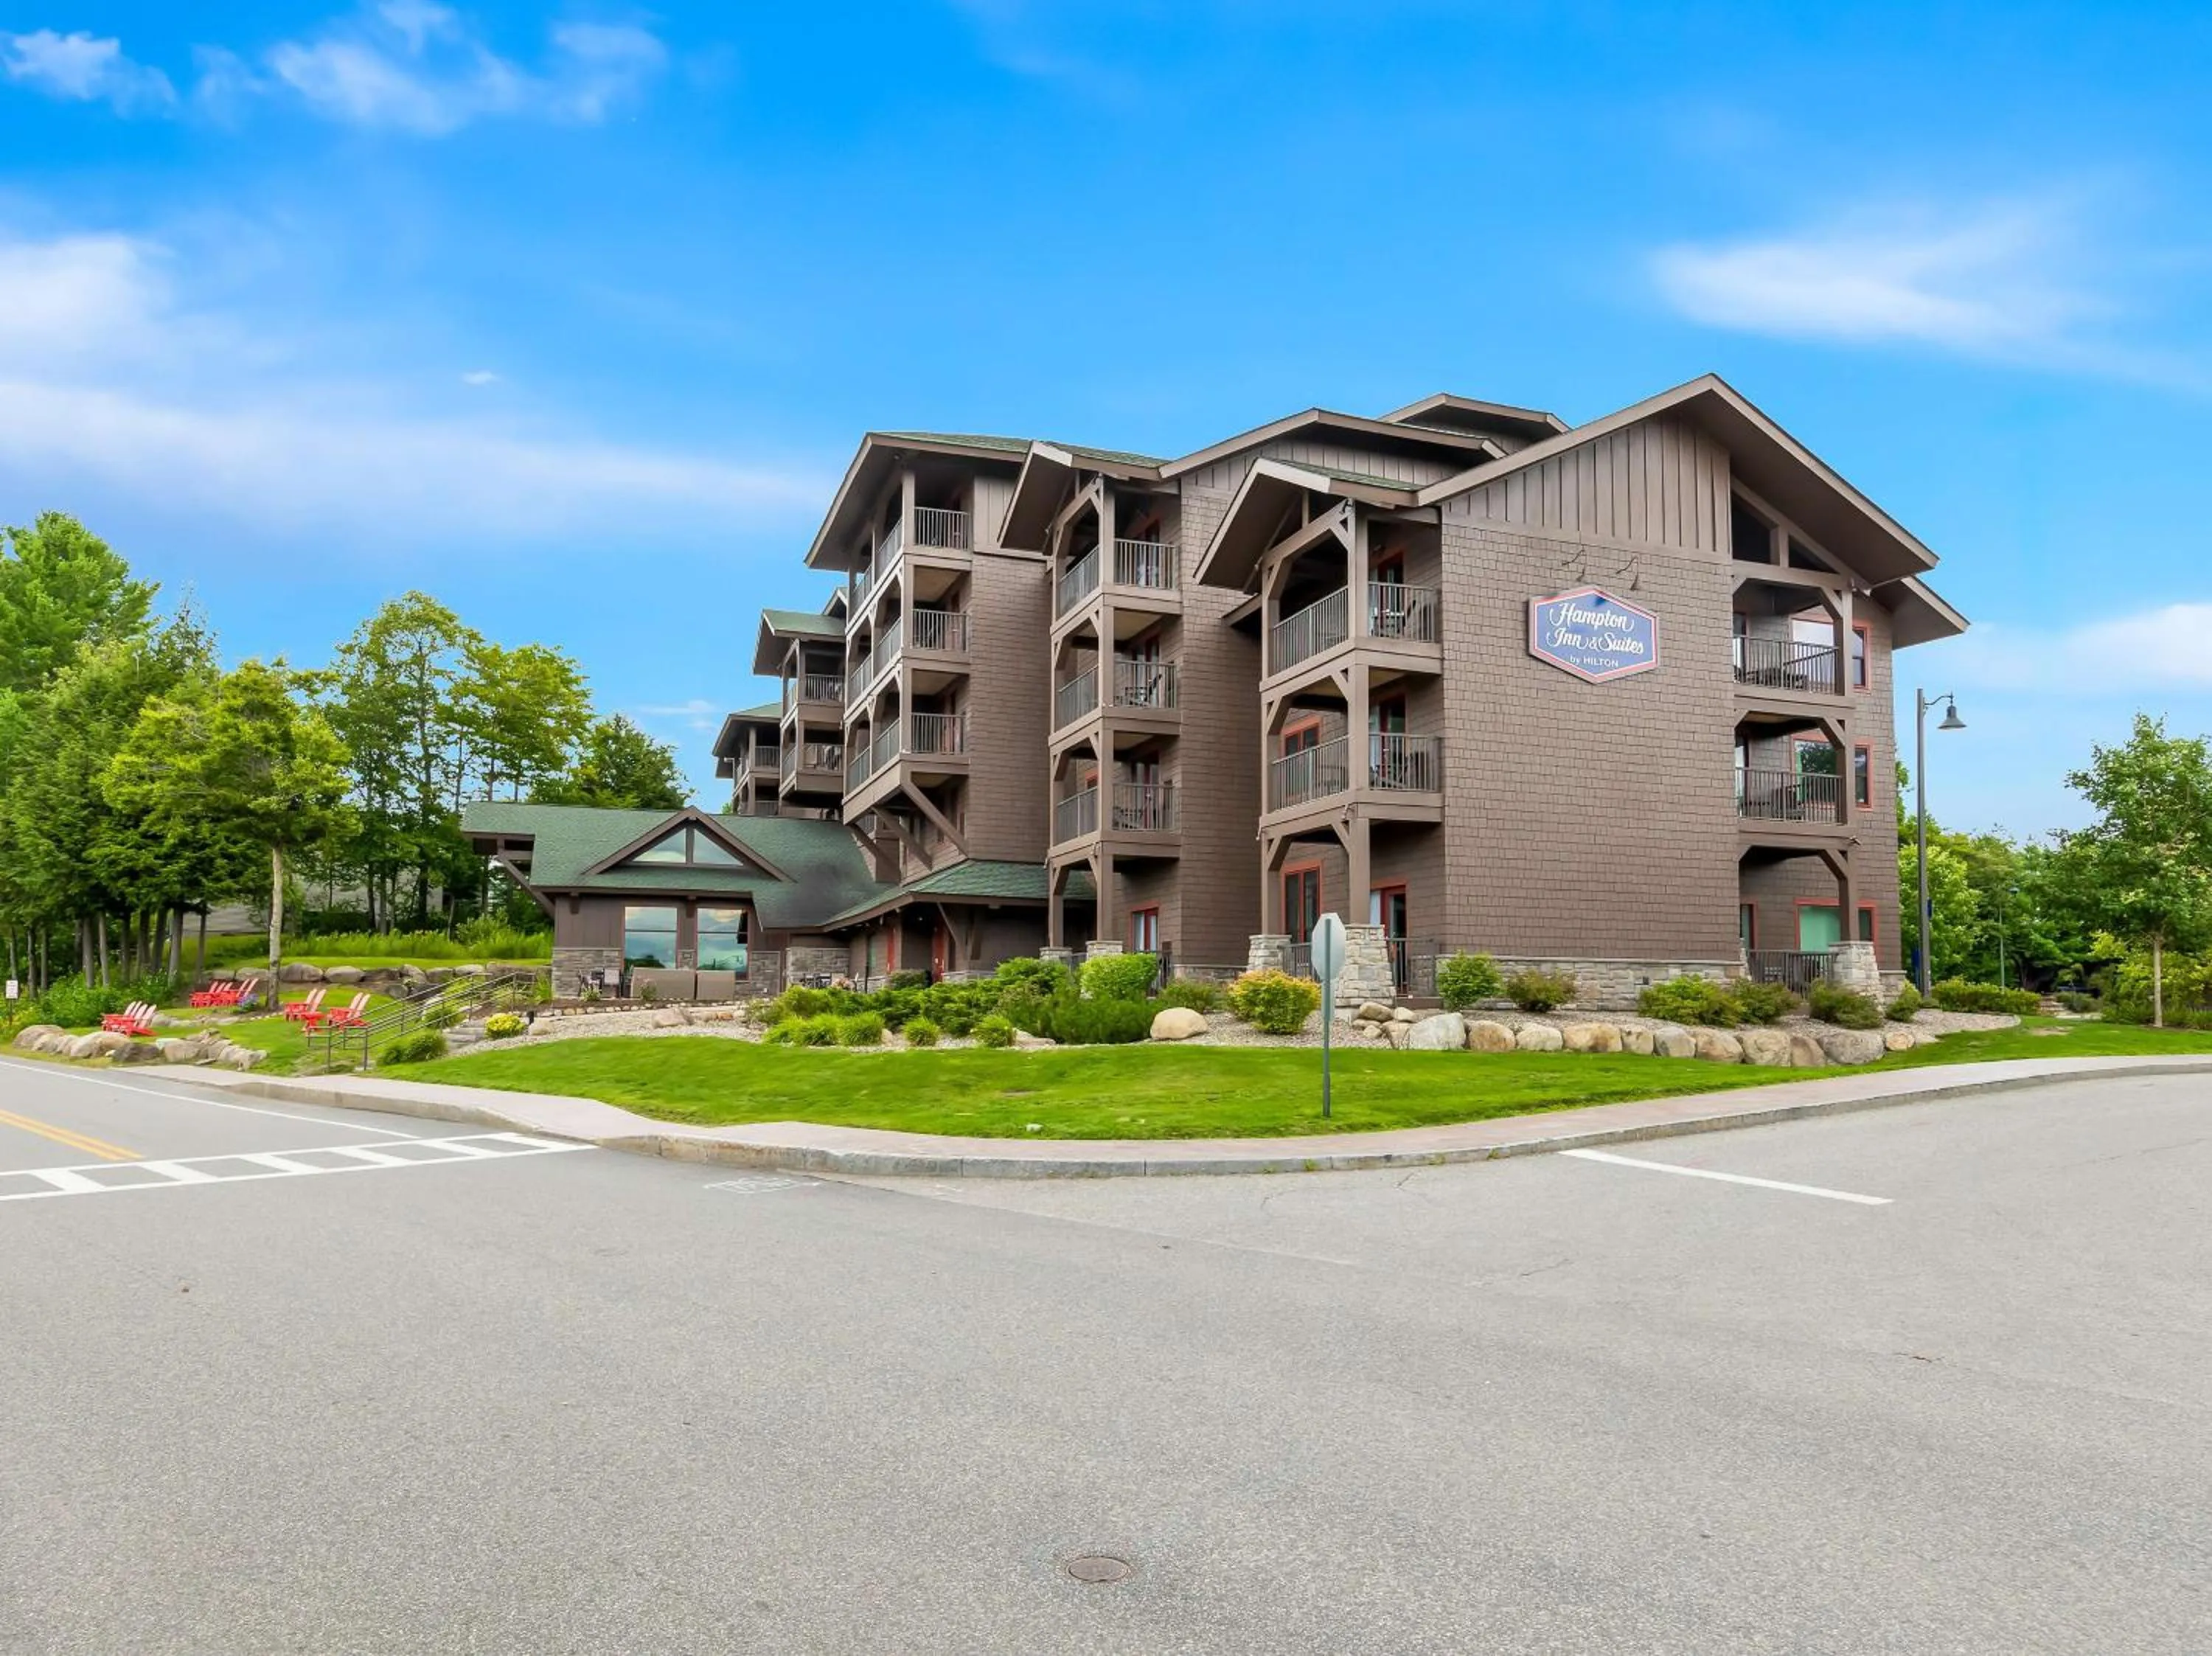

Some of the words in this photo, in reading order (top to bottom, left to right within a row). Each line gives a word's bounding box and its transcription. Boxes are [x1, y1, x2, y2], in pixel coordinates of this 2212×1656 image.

[1550, 602, 1635, 632] Hampton
[1546, 627, 1588, 649] Inn
[1588, 637, 1598, 649] &
[1598, 632, 1644, 655] Suites
[1570, 656, 1580, 666] by
[1584, 655, 1618, 667] HILTON
